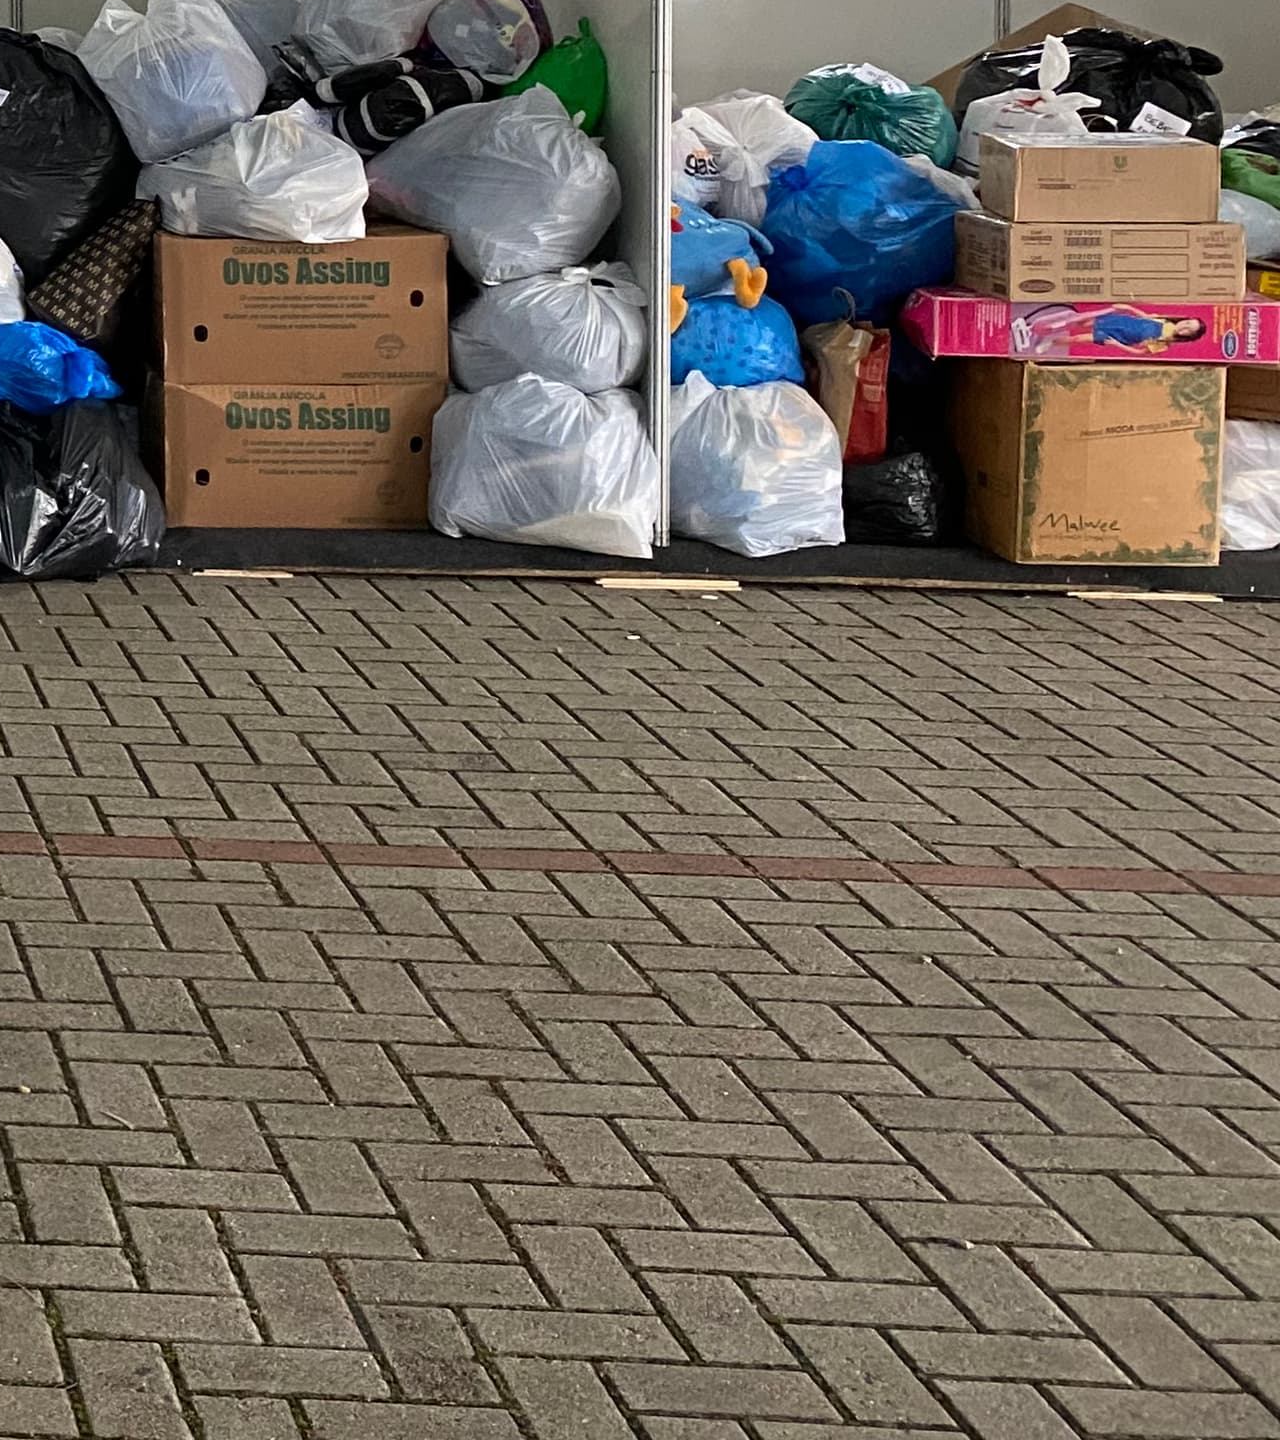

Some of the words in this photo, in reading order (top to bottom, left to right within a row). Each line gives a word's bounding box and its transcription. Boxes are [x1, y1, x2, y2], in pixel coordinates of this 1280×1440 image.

[222, 257, 289, 286] Ovos
[295, 256, 391, 287] Assing
[225, 402, 292, 430] Ovos
[298, 402, 391, 433] Assing
[1039, 512, 1121, 533] Malwee
